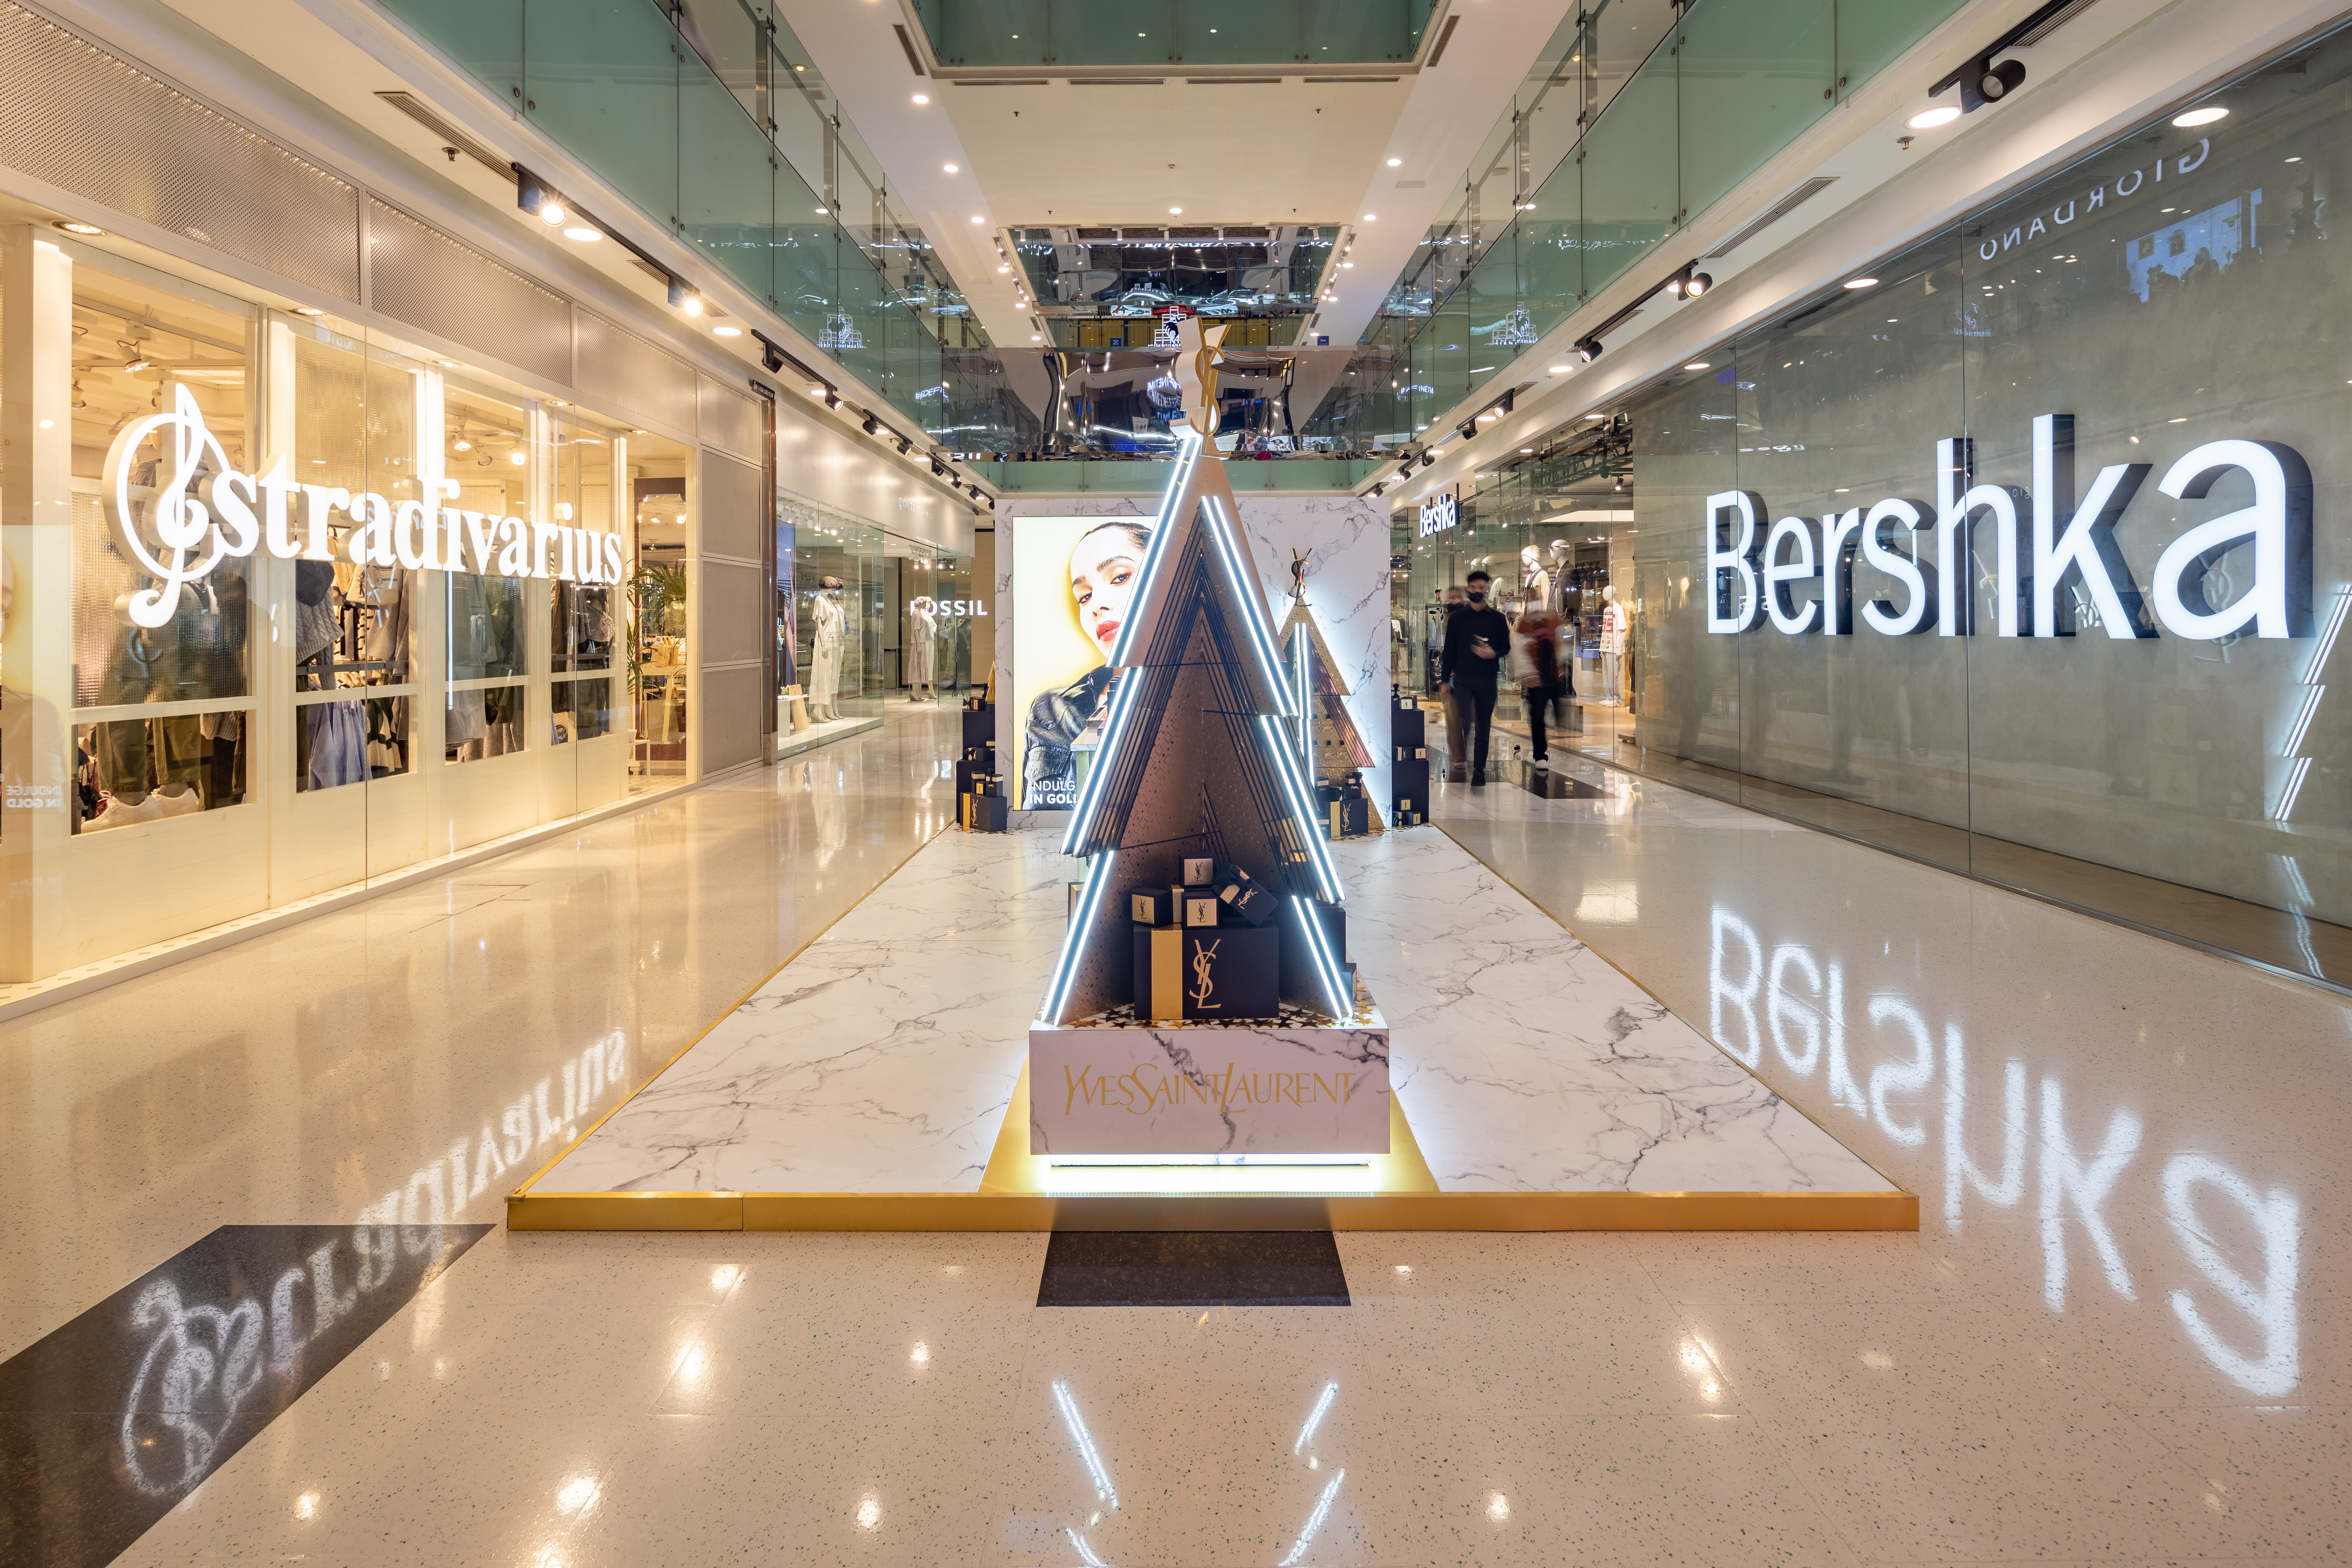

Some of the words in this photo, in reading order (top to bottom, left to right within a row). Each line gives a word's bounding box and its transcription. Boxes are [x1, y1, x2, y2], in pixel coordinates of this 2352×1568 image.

[1419, 493, 1456, 538] Bershka
[1707, 413, 2298, 639] Bershka
[1030, 780, 1077, 791] INDULG
[1030, 793, 1043, 804] IN
